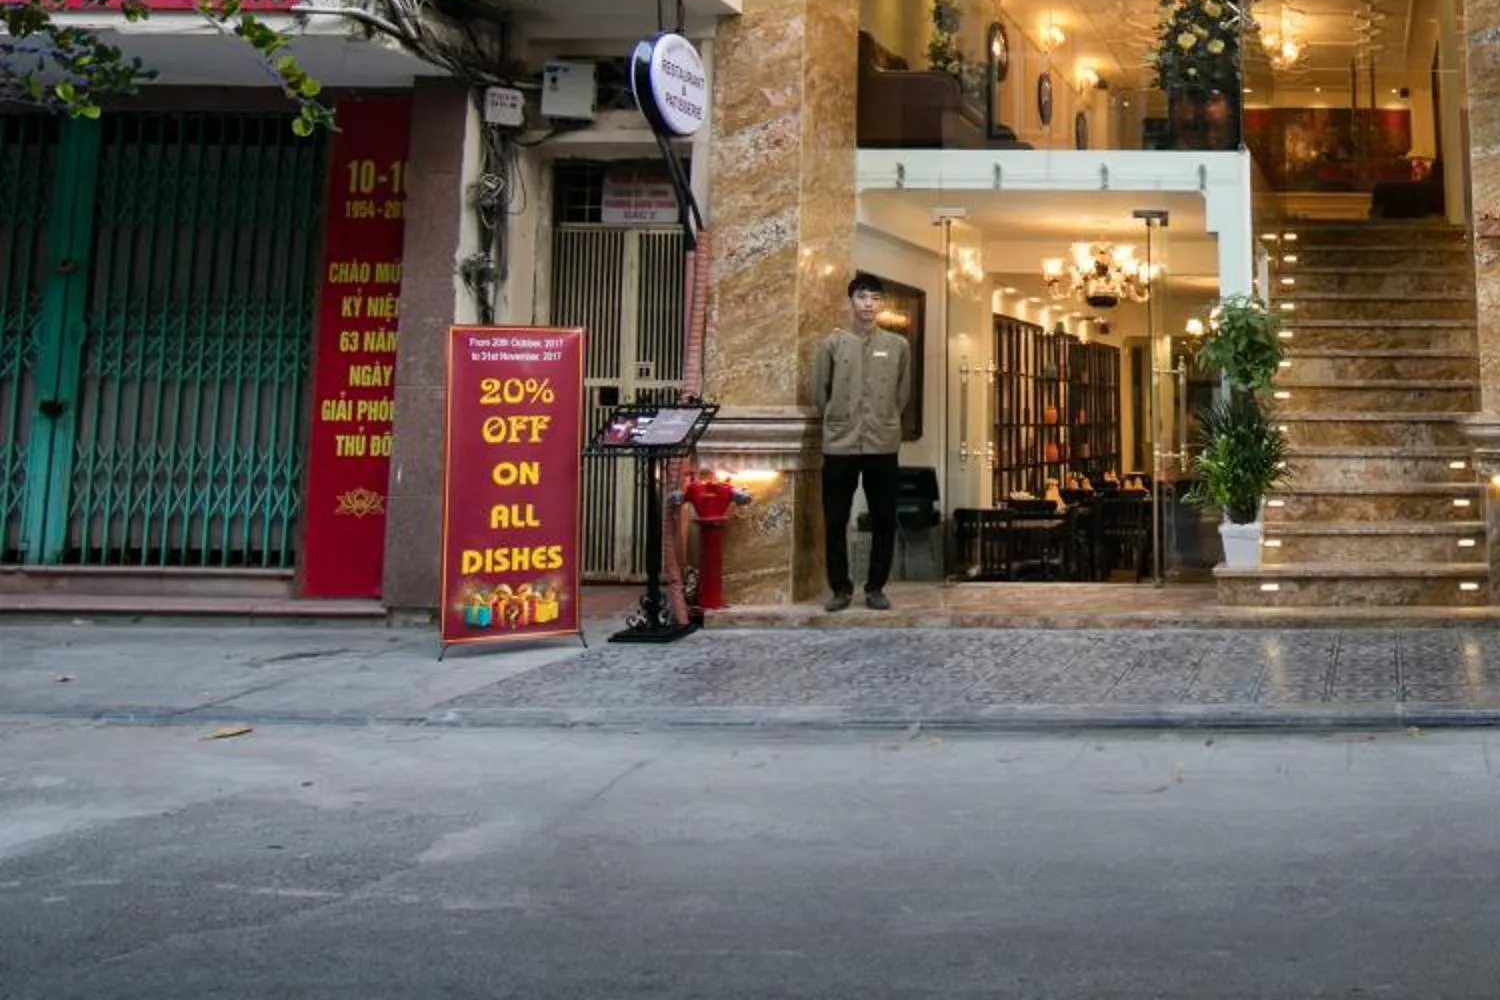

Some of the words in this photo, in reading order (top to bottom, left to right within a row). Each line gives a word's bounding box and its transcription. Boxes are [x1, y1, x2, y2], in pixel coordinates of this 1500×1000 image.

[329, 258, 370, 283] CHÀO
[339, 331, 359, 352] 63
[349, 361, 392, 386] NGÀY
[480, 377, 555, 405] 20%
[321, 391, 352, 421] GIẢI
[356, 395, 395, 421] PHÓ
[335, 426, 366, 457] THỦ
[482, 415, 551, 444] OFF
[492, 462, 541, 486] ON
[491, 503, 541, 529] ALL
[461, 544, 564, 575] DISHES
